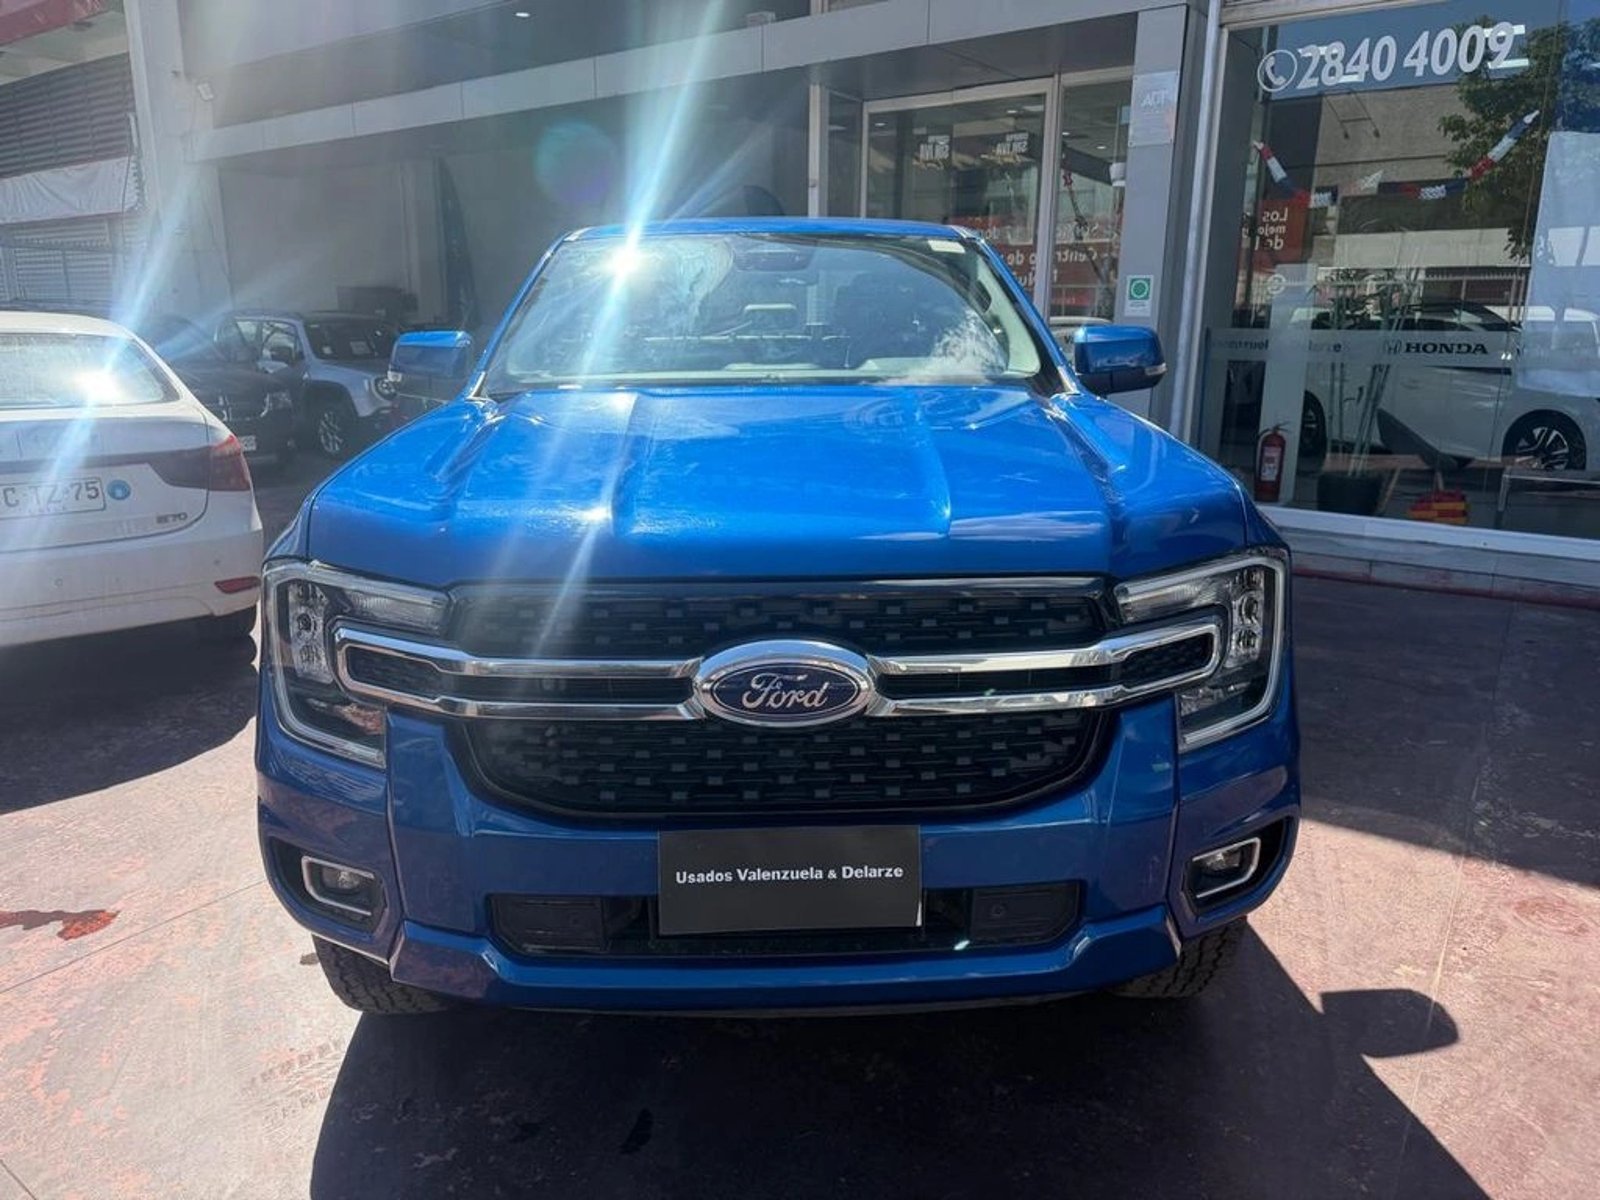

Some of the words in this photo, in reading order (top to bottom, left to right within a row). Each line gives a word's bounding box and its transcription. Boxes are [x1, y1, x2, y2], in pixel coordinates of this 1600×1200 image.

[1297, 35, 1397, 90] 2840
[1403, 21, 1515, 78] 4009
[1404, 342, 1489, 355] HONDA
[742, 671, 829, 710] Ford
[675, 869, 733, 885] Usados
[736, 866, 824, 882] Valenzuela
[828, 870, 837, 880] &
[841, 865, 904, 880] Delarze
